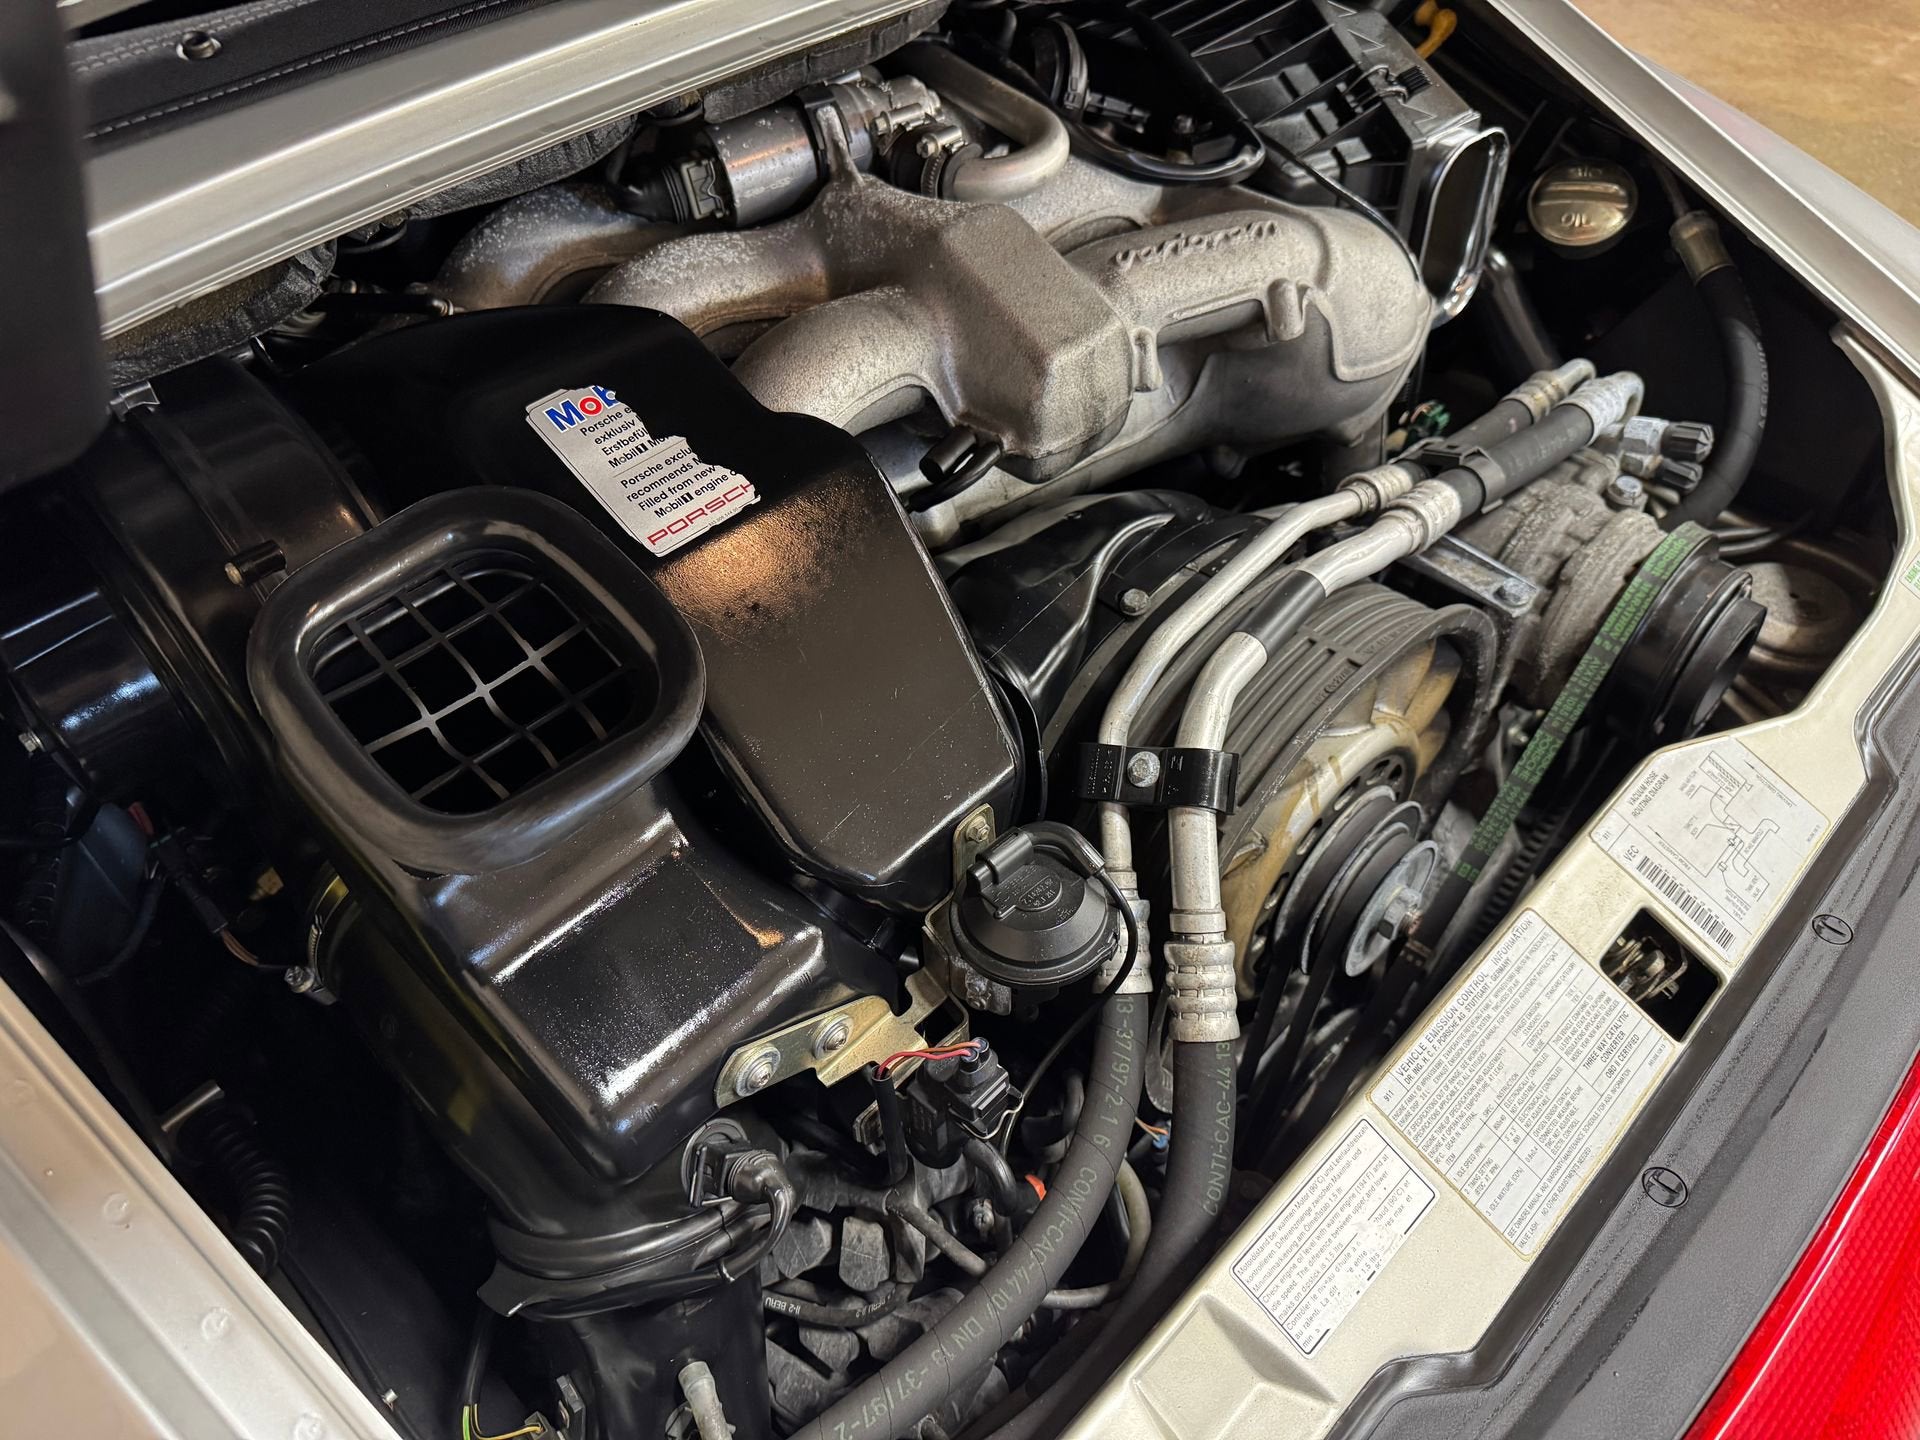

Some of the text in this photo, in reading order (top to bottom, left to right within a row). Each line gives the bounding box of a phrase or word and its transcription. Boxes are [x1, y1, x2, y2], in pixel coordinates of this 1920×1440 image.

[579, 411, 622, 436] Porsche
[594, 419, 635, 444] exklusiv
[620, 463, 663, 488] Porsche
[626, 462, 693, 501] recommends
[637, 464, 715, 510] Filled from new
[694, 474, 728, 496] engine
[1628, 770, 1658, 805] VACUUM HOSE
[1631, 773, 1669, 817] ROUTING DIAGRAM
[1623, 844, 1639, 861] VEC
[1395, 1042, 1427, 1076] VEHICLE
[1424, 1006, 1458, 1043] EMISSION
[1456, 971, 1488, 1006] CONTROL
[1491, 918, 1532, 965] INFORMATION
[1436, 1019, 1459, 1045] PORSCHE
[1456, 1011, 1466, 1022] AG
[1464, 982, 1489, 1012] STUTTGART
[1490, 956, 1511, 981] GERMANY
[1582, 1010, 1629, 1069] THREE WAY CATALYTIC
[1600, 1030, 1625, 1062] CONVERTER
[1605, 1064, 1616, 1078] OBD
[1617, 1033, 1639, 1061] CERTIFIED
[1383, 1089, 1394, 1102] 911
[1200, 1064, 1236, 1216] CONTI-CAC-44
